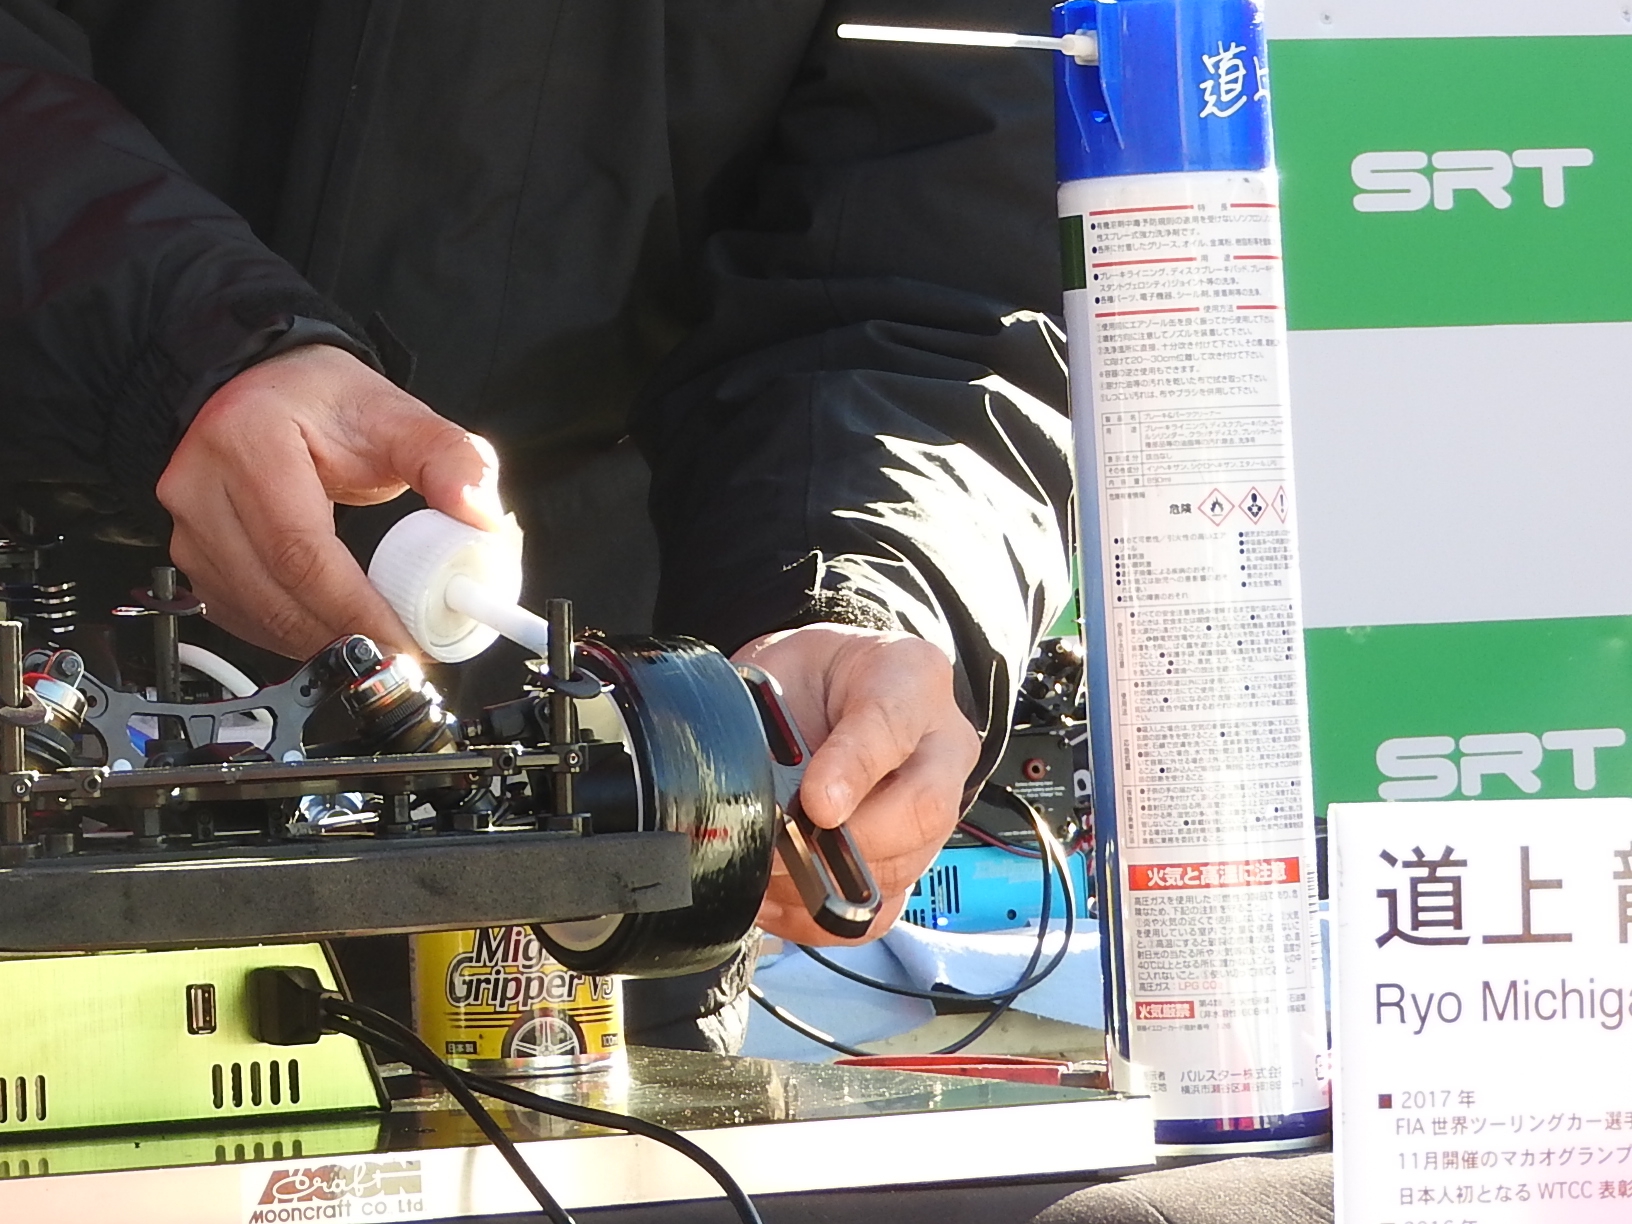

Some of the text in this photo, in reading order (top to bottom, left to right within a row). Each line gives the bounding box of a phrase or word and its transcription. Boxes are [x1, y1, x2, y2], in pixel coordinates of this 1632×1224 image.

[1351, 148, 1593, 212] SRT
[1375, 728, 1625, 800] SRT
[1146, 861, 1287, 886] 火気と高温に注意
[1375, 845, 1573, 949] 道上
[445, 953, 583, 1012] Gripper
[1138, 1003, 1190, 1019] 火気厳禁
[1375, 977, 1632, 1035] Ryo Michig
[1401, 1089, 1476, 1109] 2017 年
[1396, 1118, 1425, 1135] FIA
[1400, 1183, 1532, 1206] 日本人初となる
[1538, 1180, 1593, 1201] WTCC
